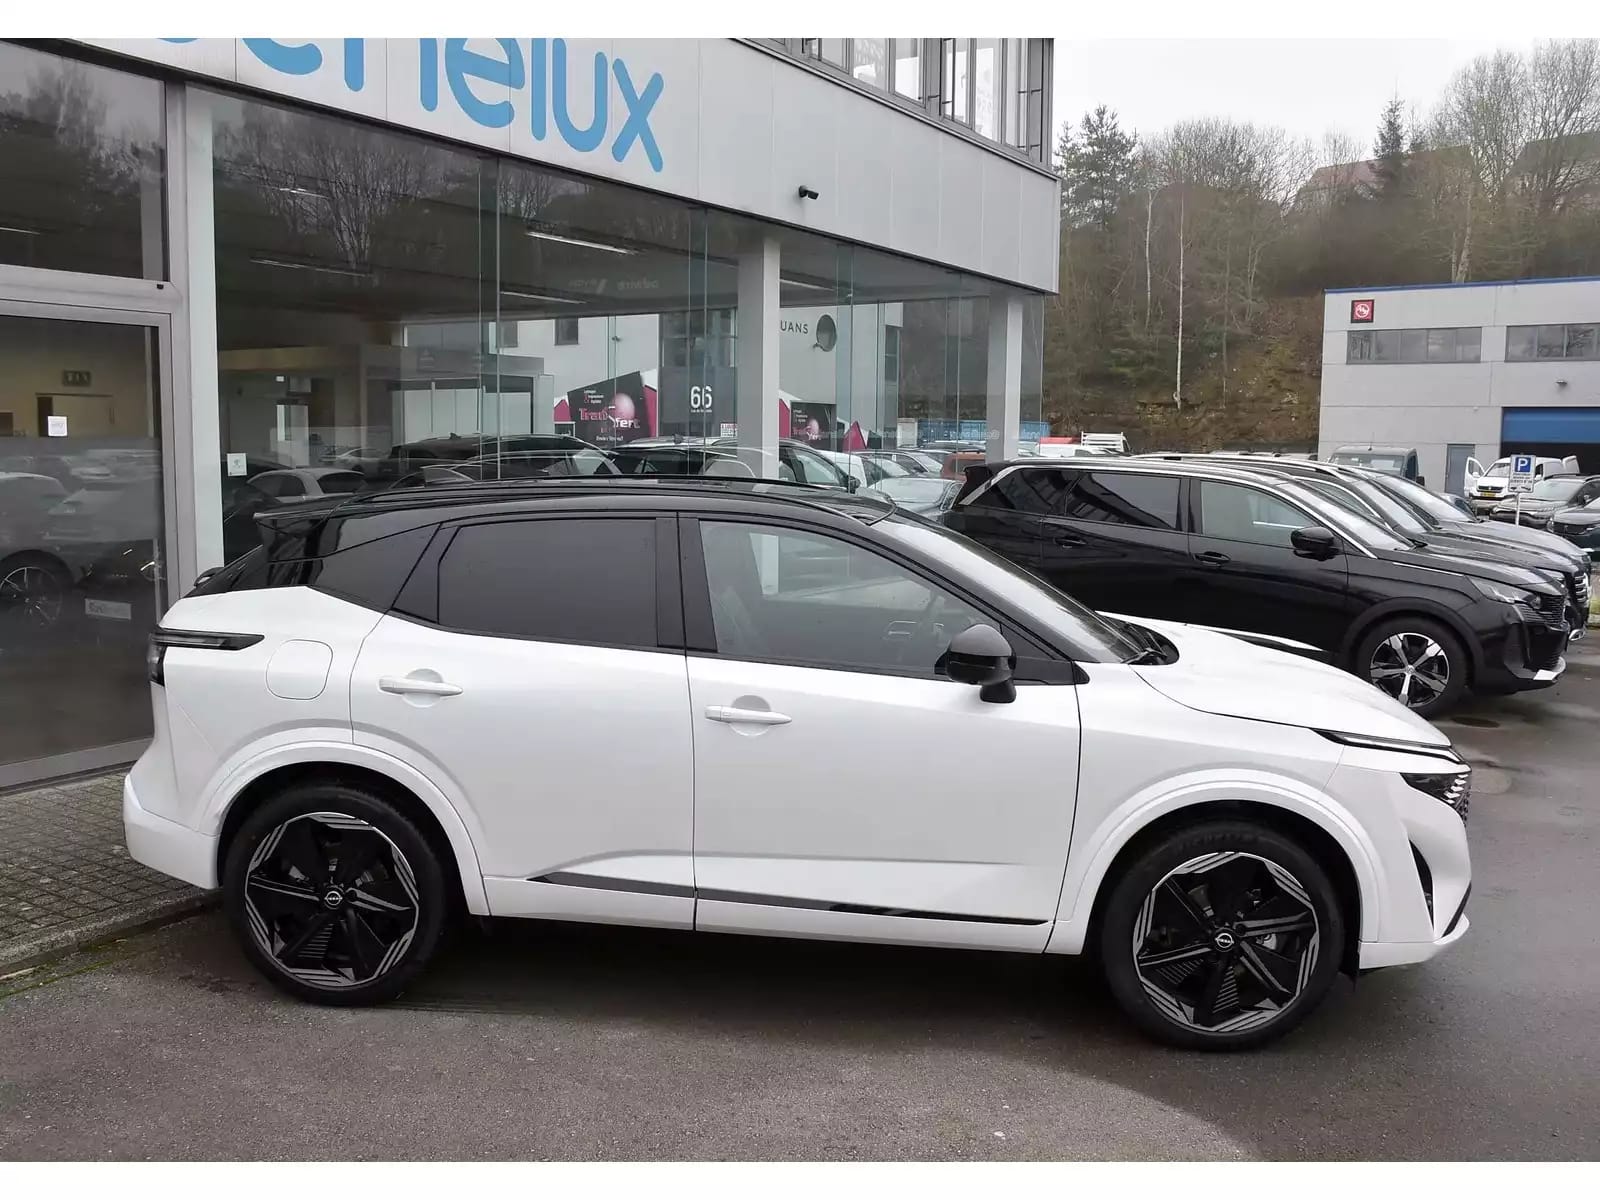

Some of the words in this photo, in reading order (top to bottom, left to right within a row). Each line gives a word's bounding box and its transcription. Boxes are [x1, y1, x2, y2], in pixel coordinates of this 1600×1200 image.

[157, 38, 664, 173] elux
[690, 385, 713, 409] 66
[1517, 458, 1528, 471] P
